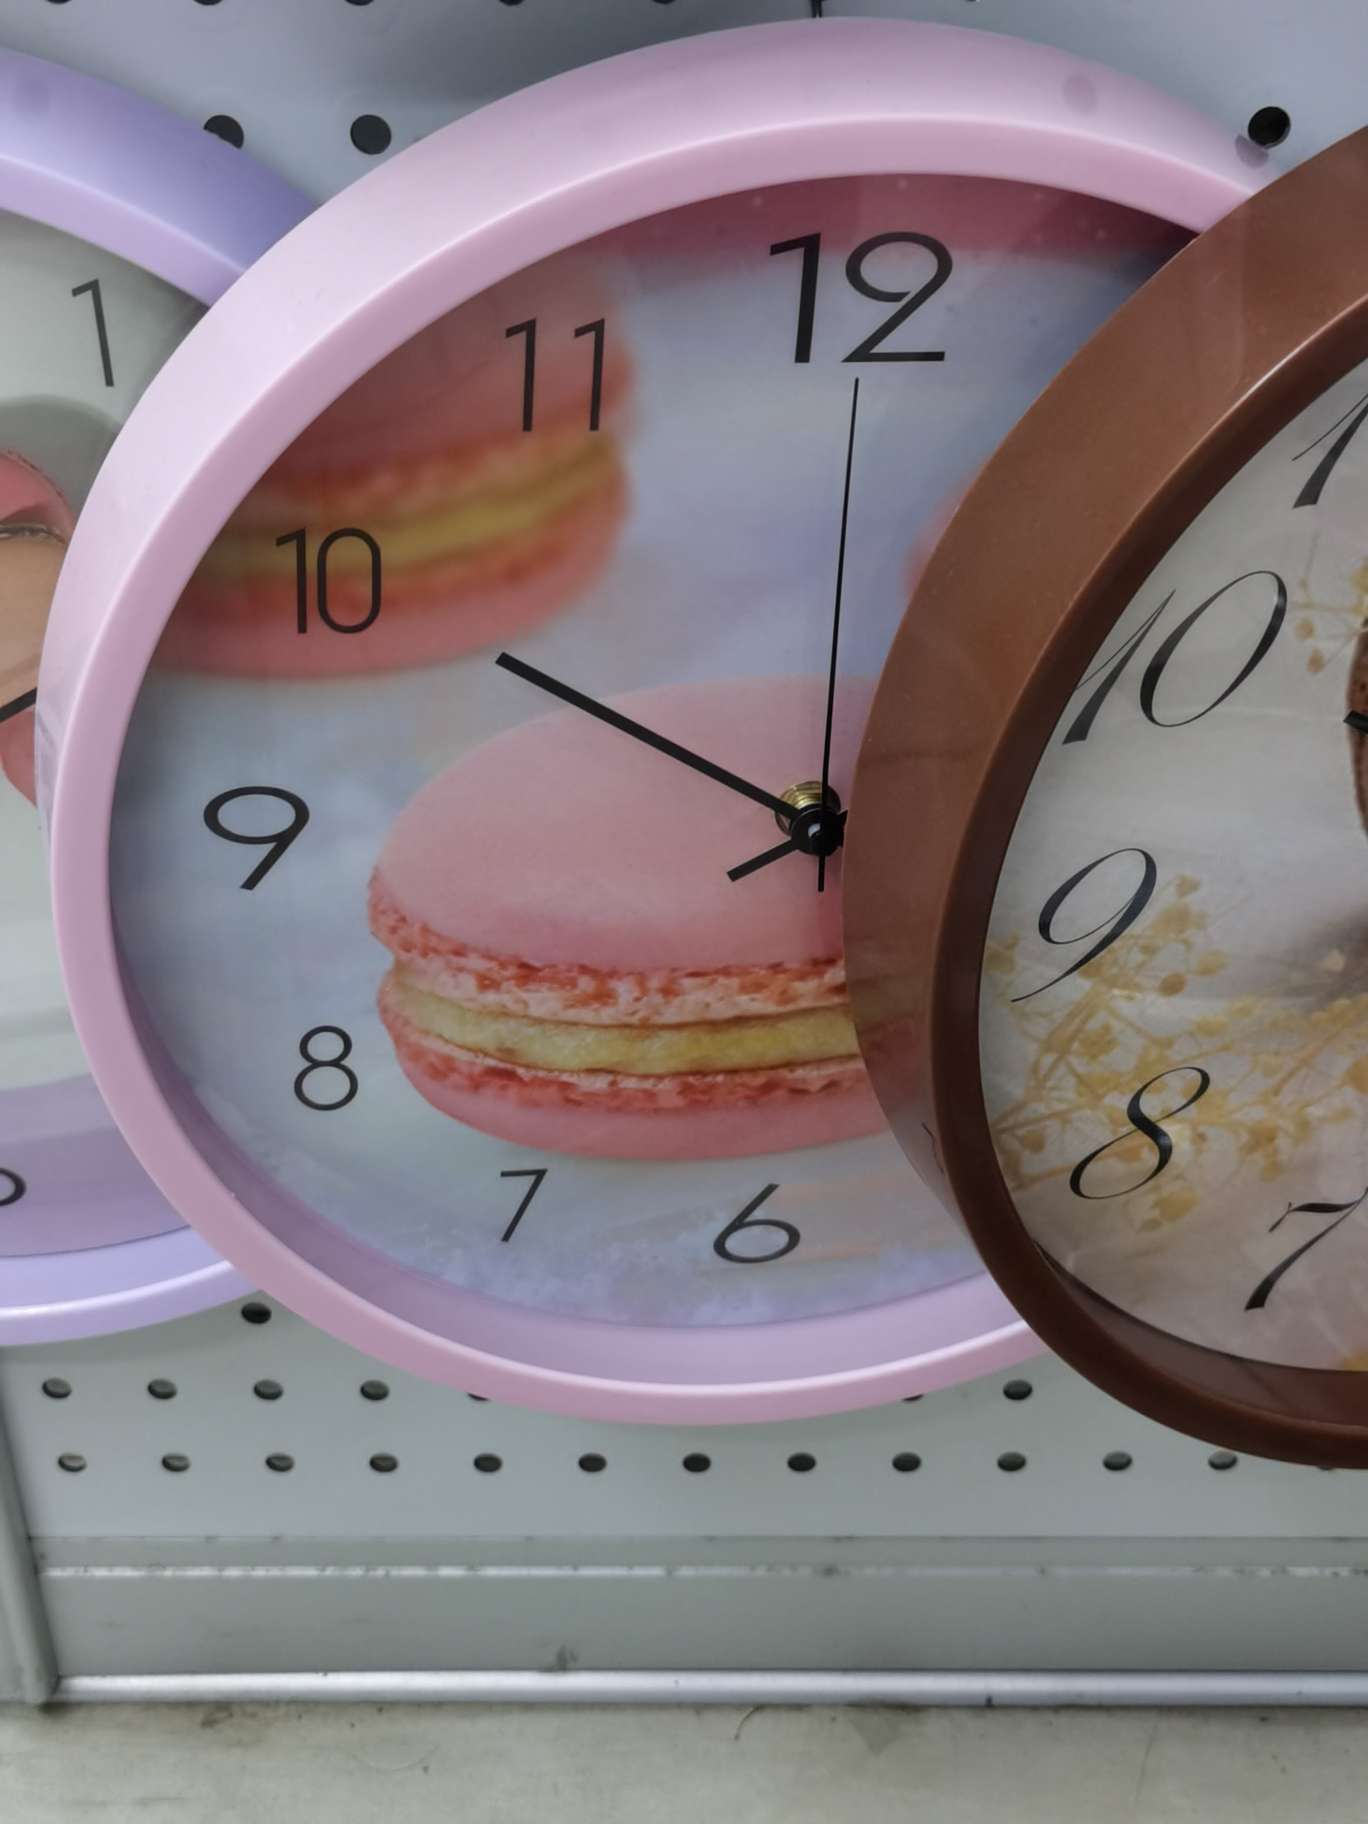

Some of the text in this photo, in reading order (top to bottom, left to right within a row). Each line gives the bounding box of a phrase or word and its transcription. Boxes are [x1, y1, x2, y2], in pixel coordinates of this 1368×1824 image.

[71, 279, 115, 388] 1
[769, 231, 954, 364] 12
[505, 317, 606, 432] 11
[275, 527, 383, 635] 10
[1062, 570, 1288, 745] 10
[202, 785, 310, 892] 9
[1010, 847, 1158, 1003] 9
[293, 1025, 359, 1112] 8
[1069, 1066, 1211, 1200] 8
[499, 1168, 548, 1243] 7
[712, 1183, 801, 1264] 6
[1244, 1186, 1368, 1311] 7
